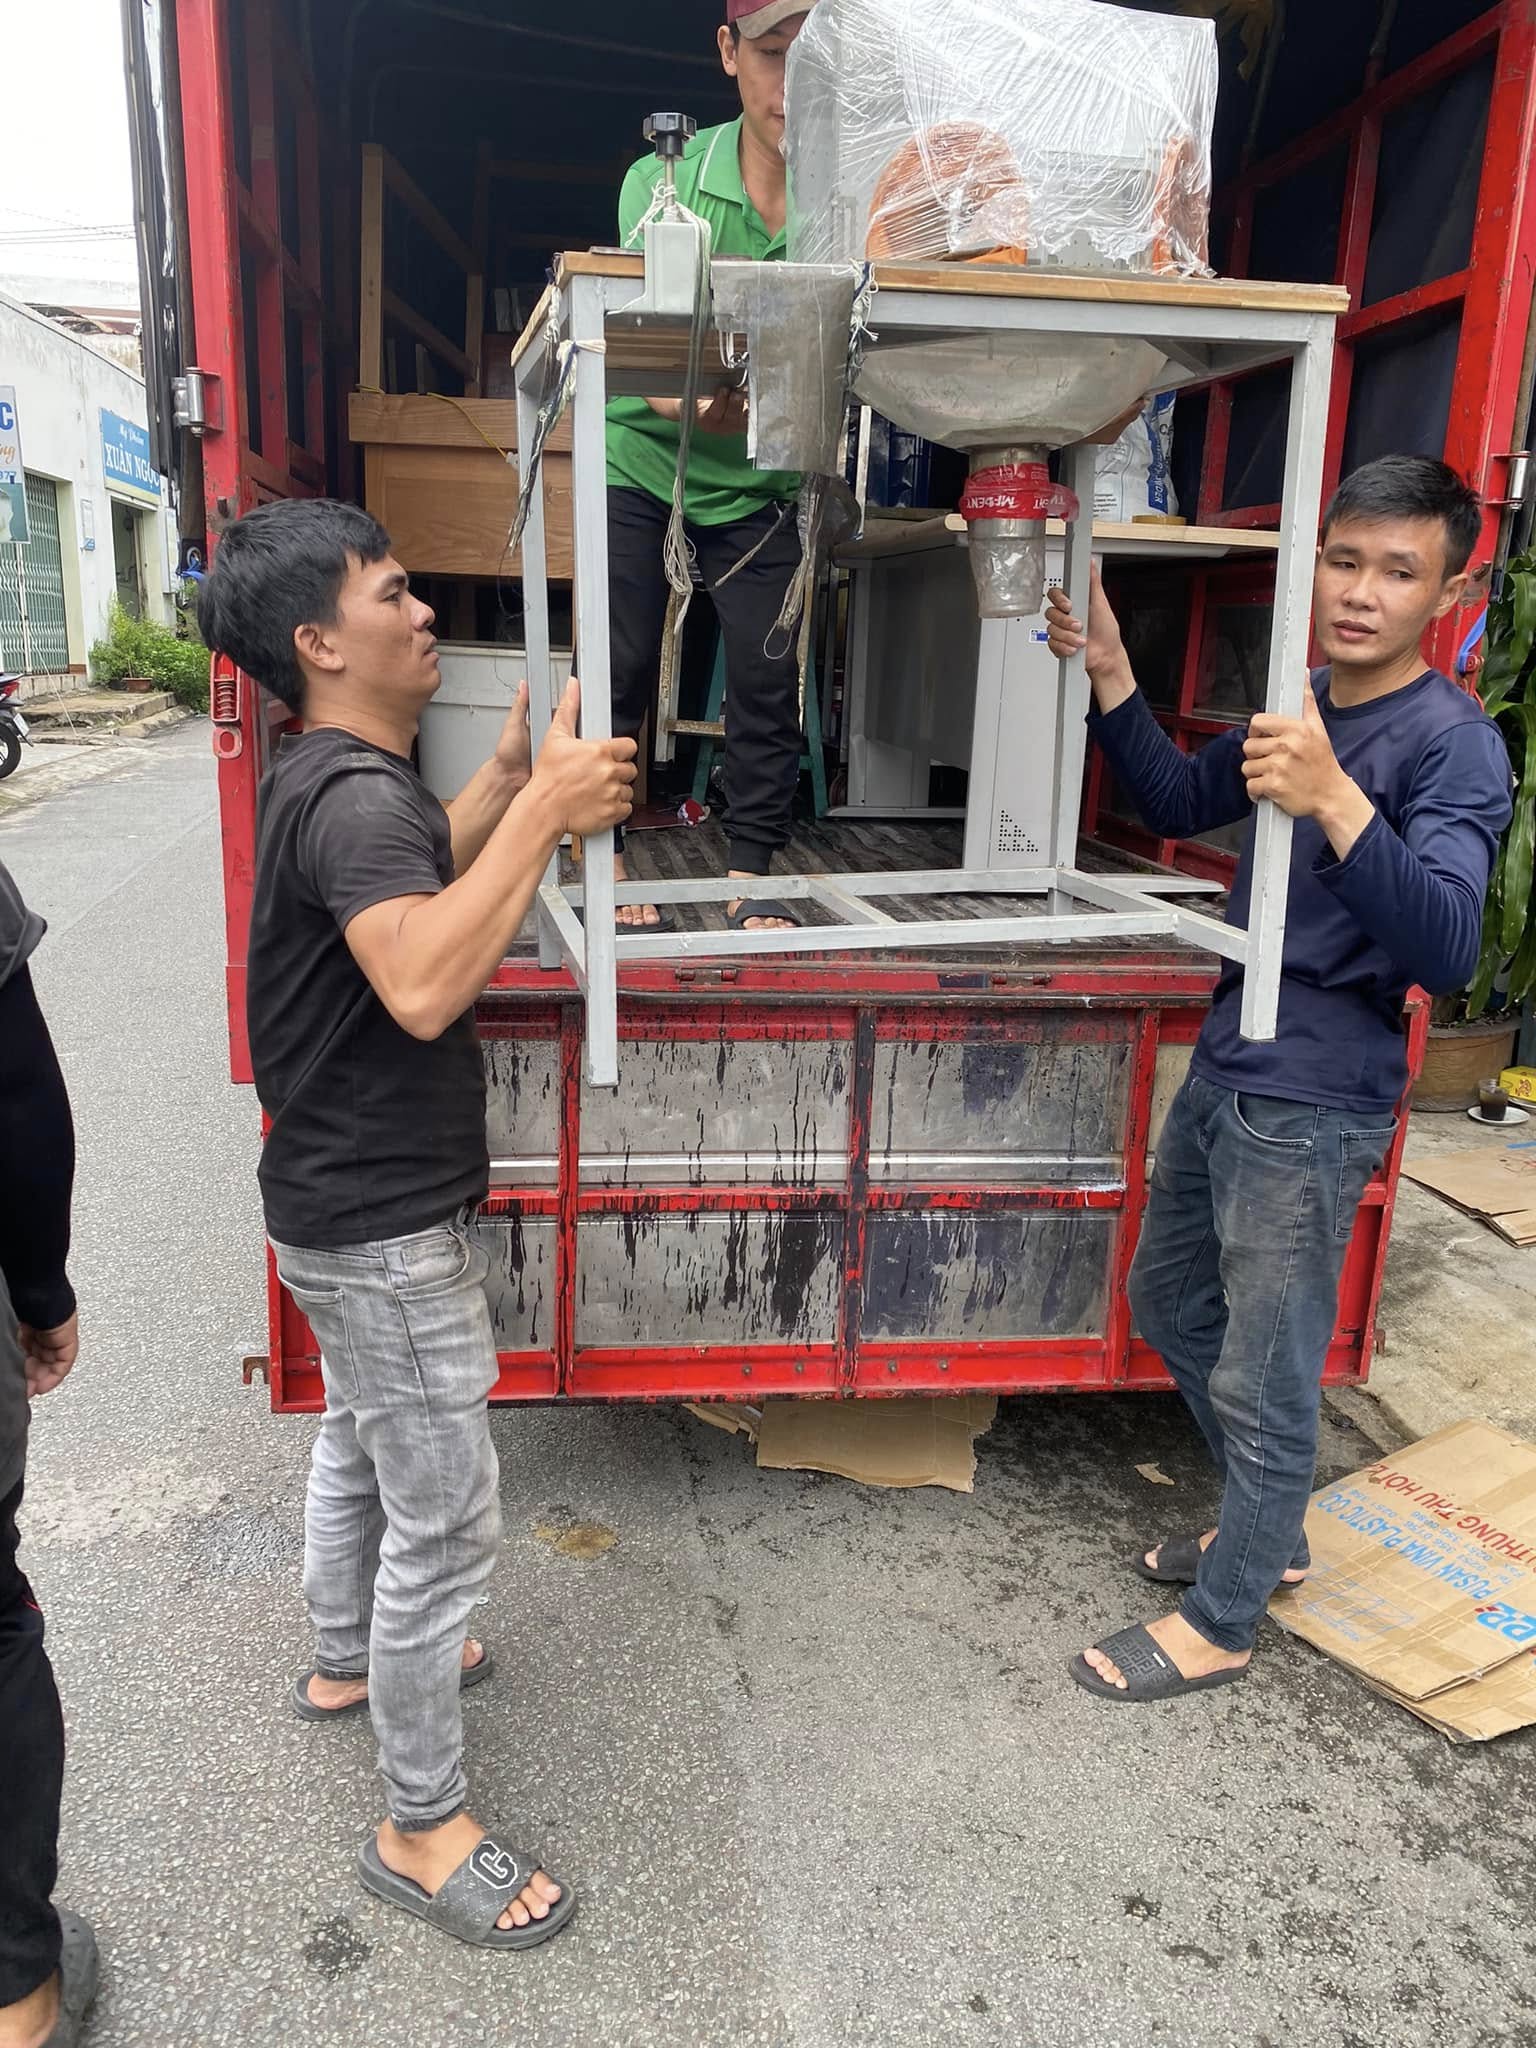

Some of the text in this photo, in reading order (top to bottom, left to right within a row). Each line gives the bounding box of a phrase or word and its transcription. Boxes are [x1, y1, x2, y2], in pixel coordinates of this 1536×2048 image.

[134, 455, 160, 489] NGỌC
[1413, 1492, 1461, 1520] THU
[1338, 1506, 1411, 1548] PLASTIC
[1399, 1540, 1445, 1570] VINA
[1432, 1563, 1502, 1599] PUSAN
[470, 1841, 518, 1890] C
